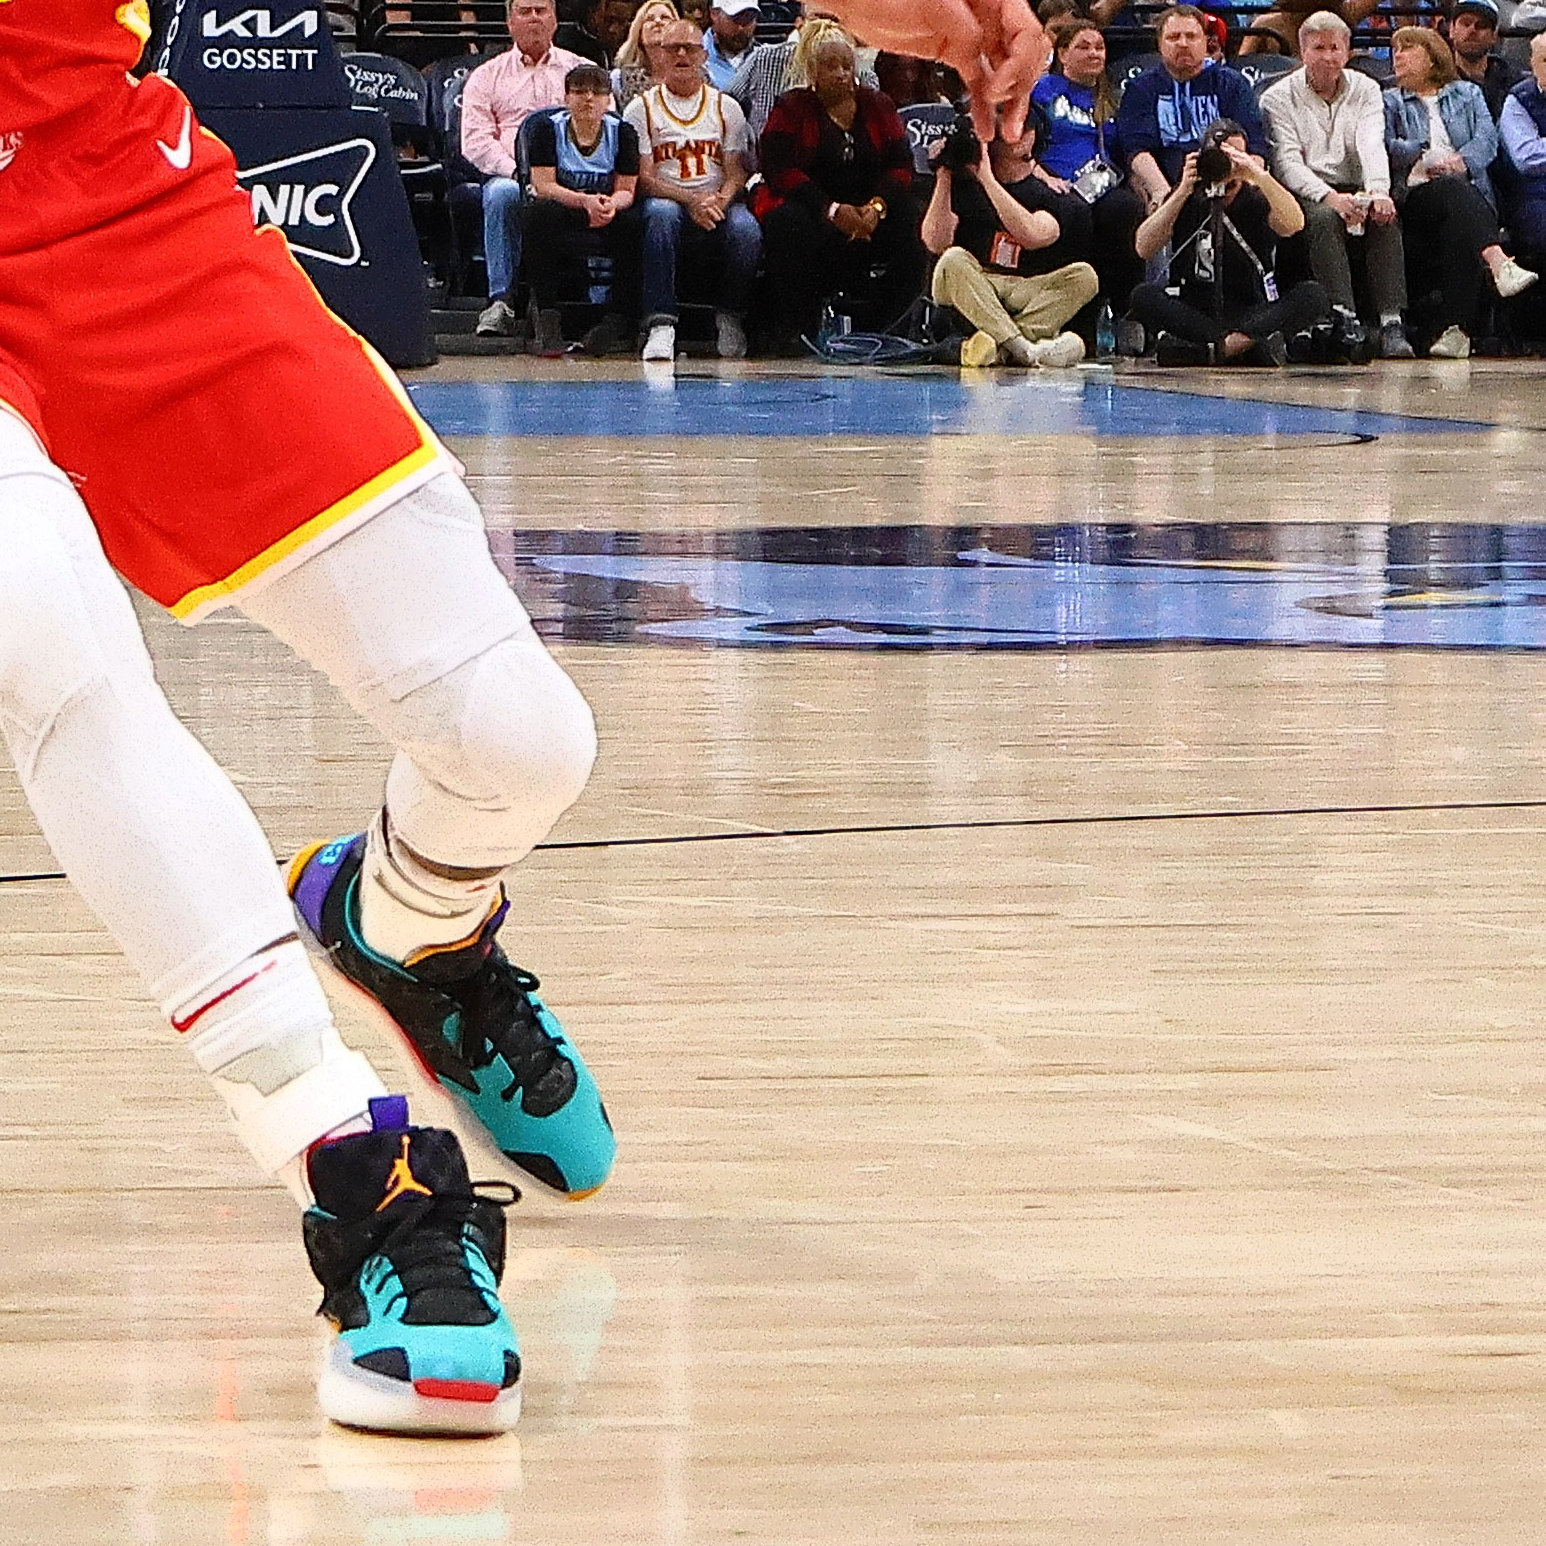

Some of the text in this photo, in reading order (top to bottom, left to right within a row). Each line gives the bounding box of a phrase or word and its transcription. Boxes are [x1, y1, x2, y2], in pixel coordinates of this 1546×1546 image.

[203, 9, 318, 38] KIA
[203, 48, 318, 70] GOSSETT
[344, 64, 398, 88] Sissy's
[356, 81, 419, 101] Log Cabin
[252, 184, 340, 227] NIC
